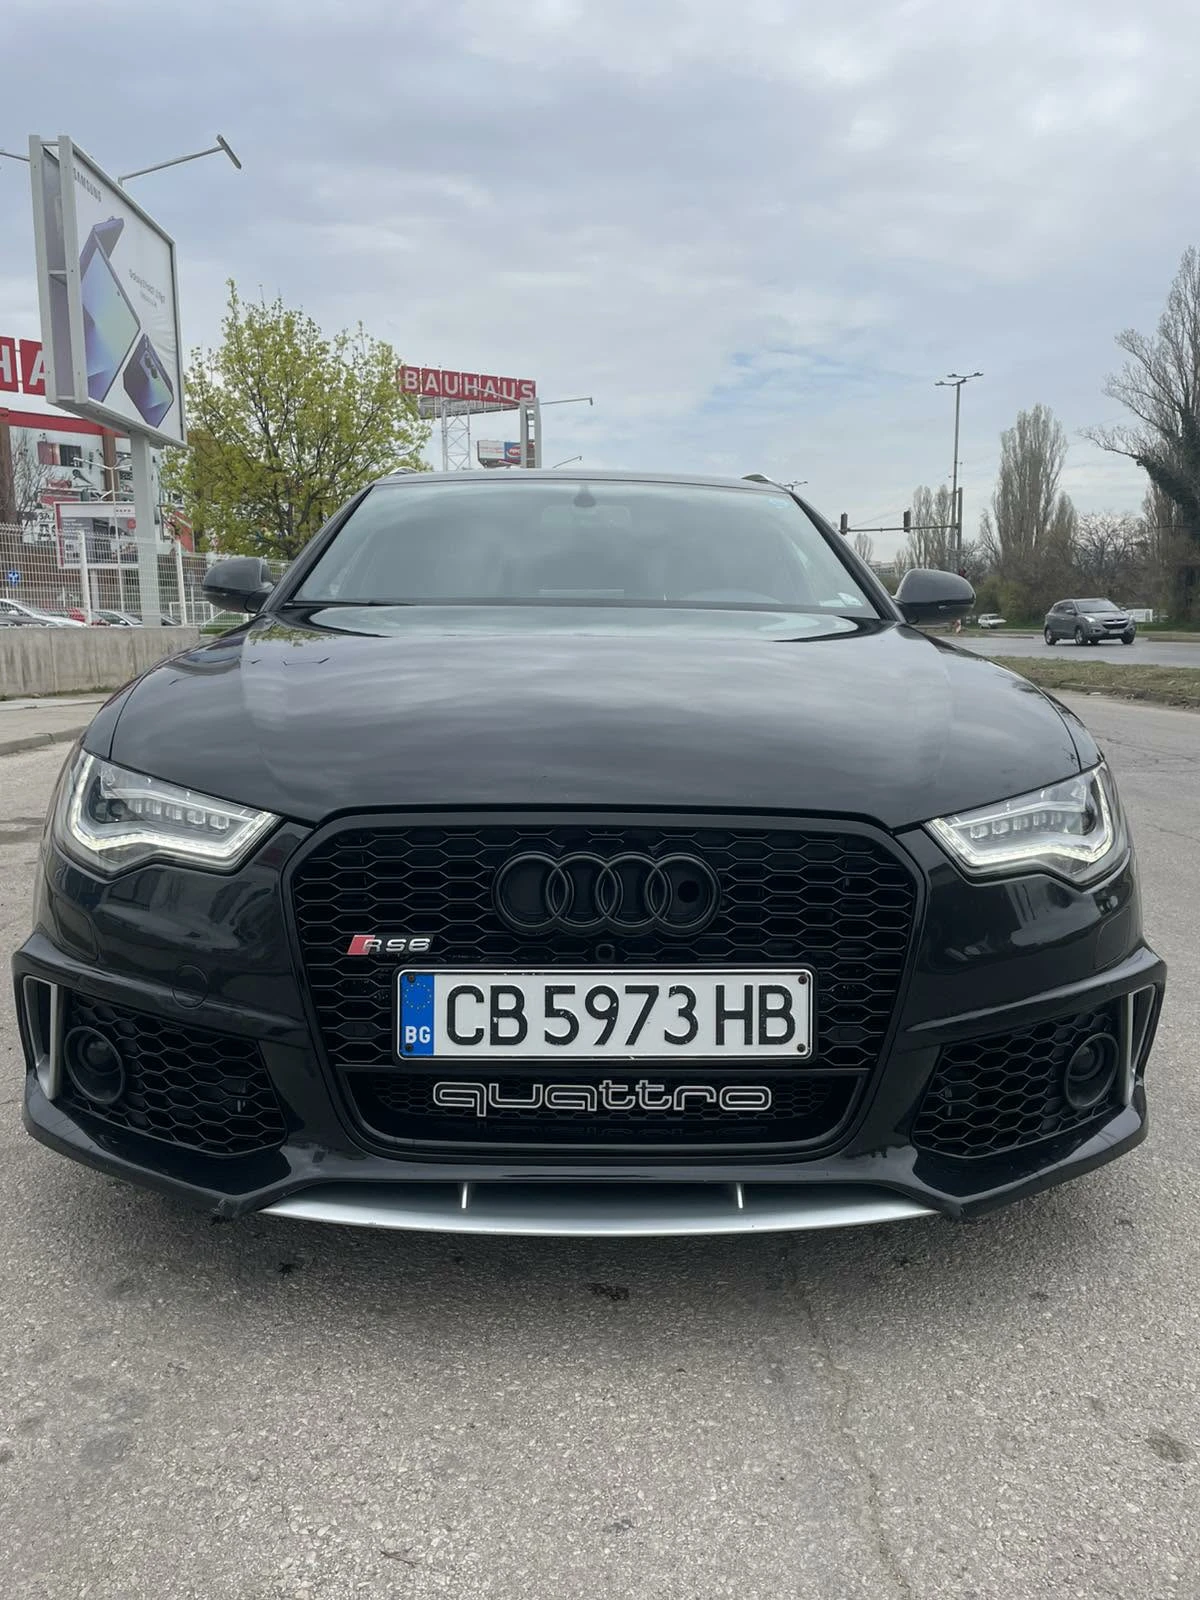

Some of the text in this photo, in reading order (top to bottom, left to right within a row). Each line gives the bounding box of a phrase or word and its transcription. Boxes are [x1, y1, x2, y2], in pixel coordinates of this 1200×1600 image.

[404, 370, 534, 401] BAUHAUS
[362, 936, 431, 954] RS6
[446, 984, 796, 1046] CB 5973 HB
[405, 1025, 431, 1044] BG
[432, 1079, 772, 1117] quattro
